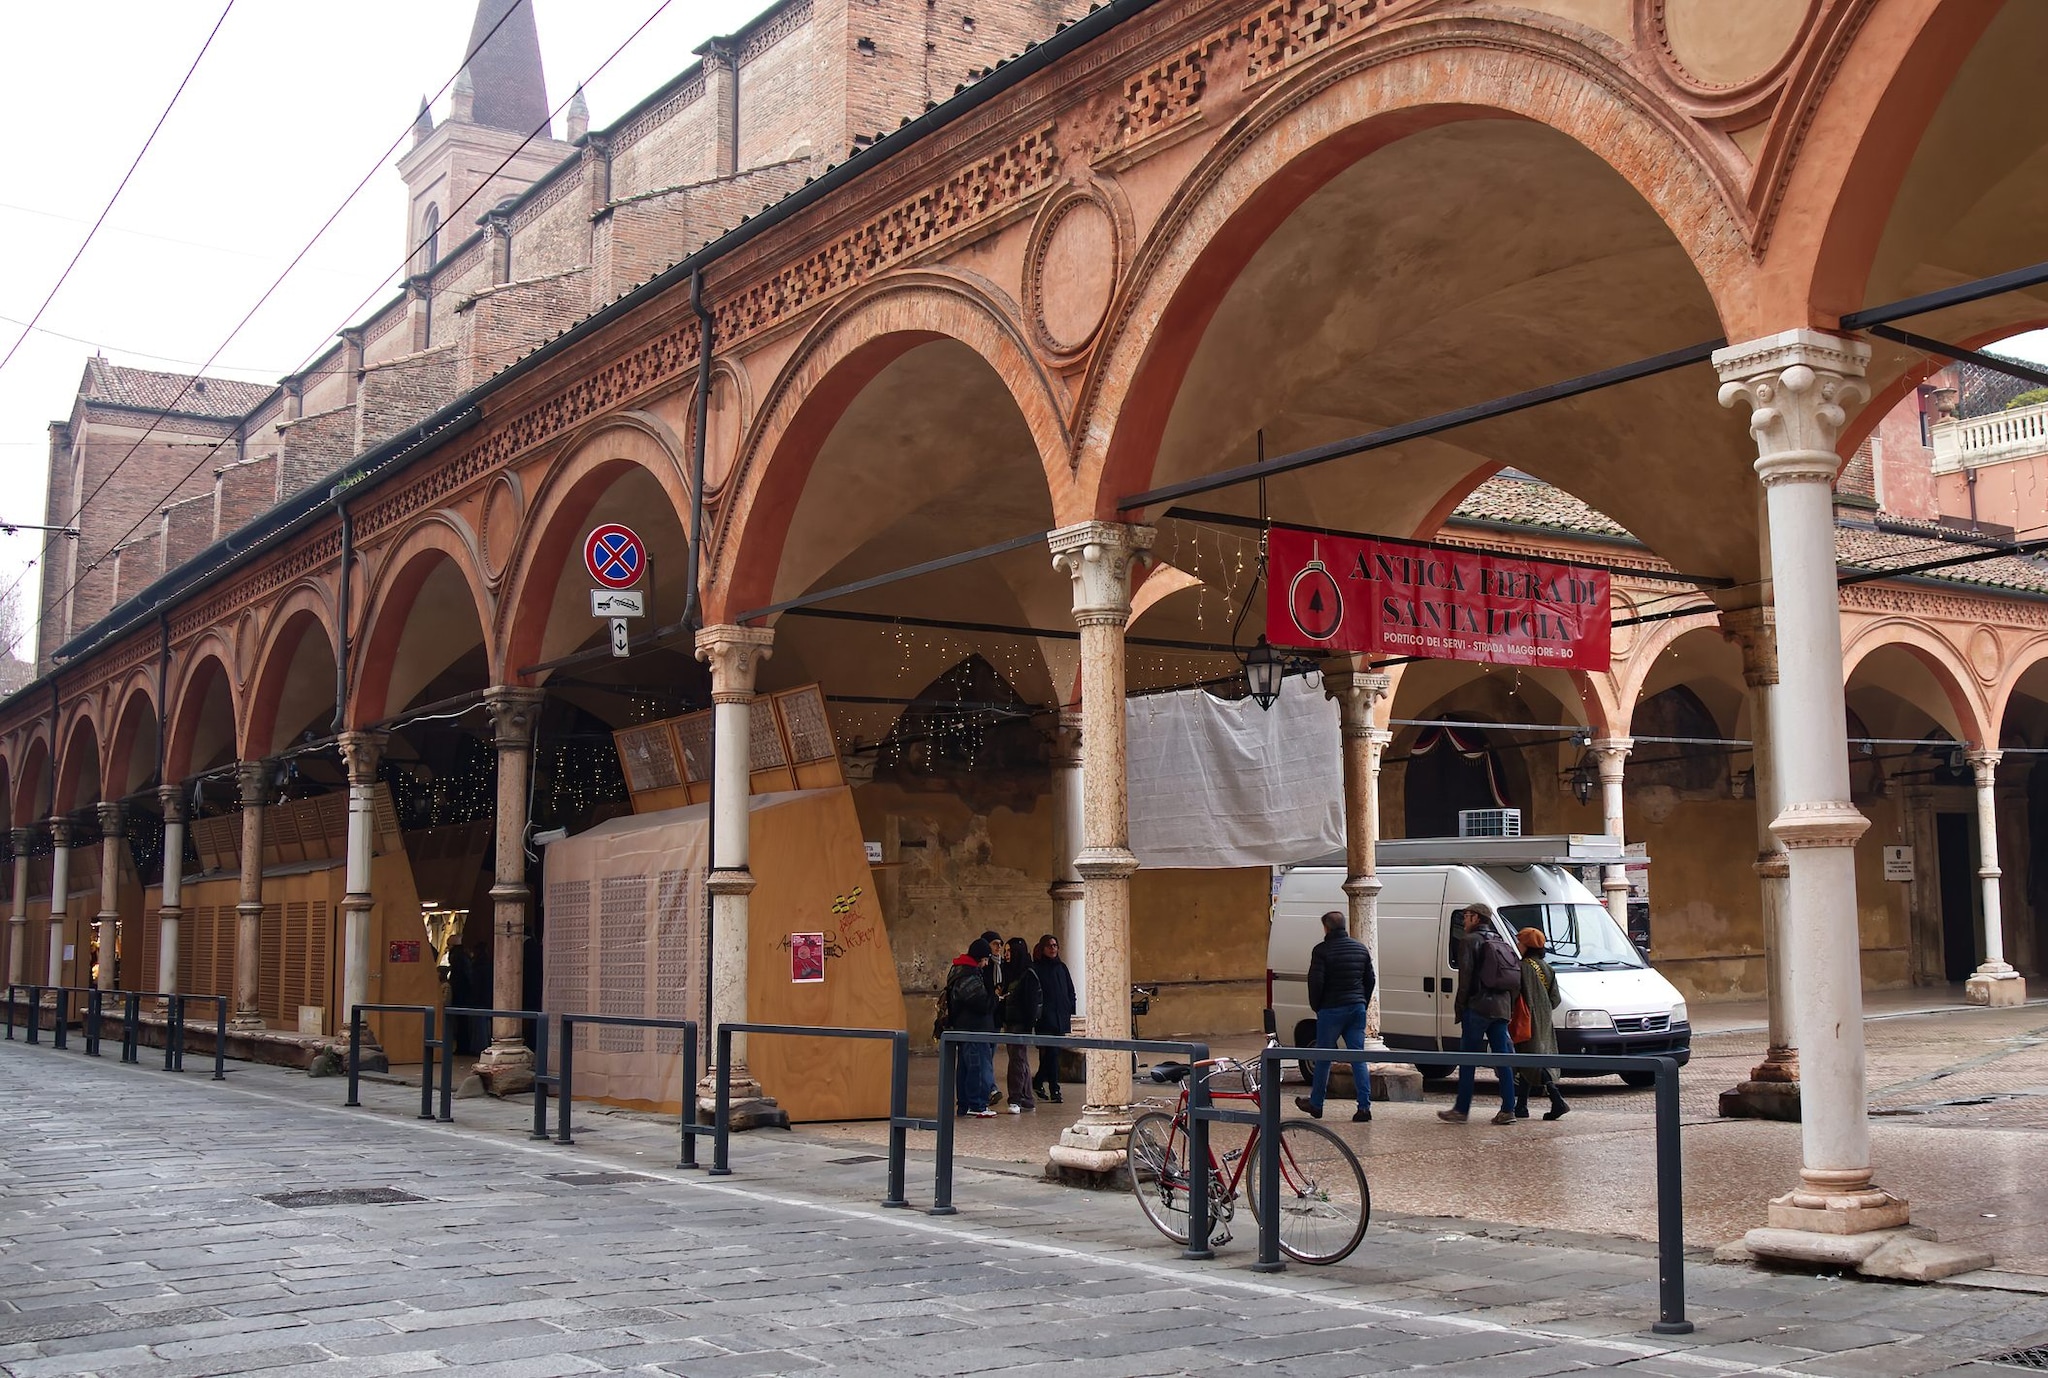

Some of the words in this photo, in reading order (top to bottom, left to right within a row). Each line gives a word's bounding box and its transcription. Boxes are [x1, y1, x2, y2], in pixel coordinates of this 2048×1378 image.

[1348, 549, 1466, 592] ANTICA
[1478, 567, 1563, 604] FIERA
[1568, 578, 1598, 607] DI
[1382, 596, 1480, 635] SANTA
[1485, 608, 1572, 642] LUCIA
[1383, 632, 1424, 646] PORTICO
[1427, 636, 1441, 648] DEI
[1443, 638, 1466, 651] SERVI
[1473, 641, 1505, 654] STRADA
[1507, 645, 1554, 658] MAGGIORE
[1561, 648, 1574, 659] BO
